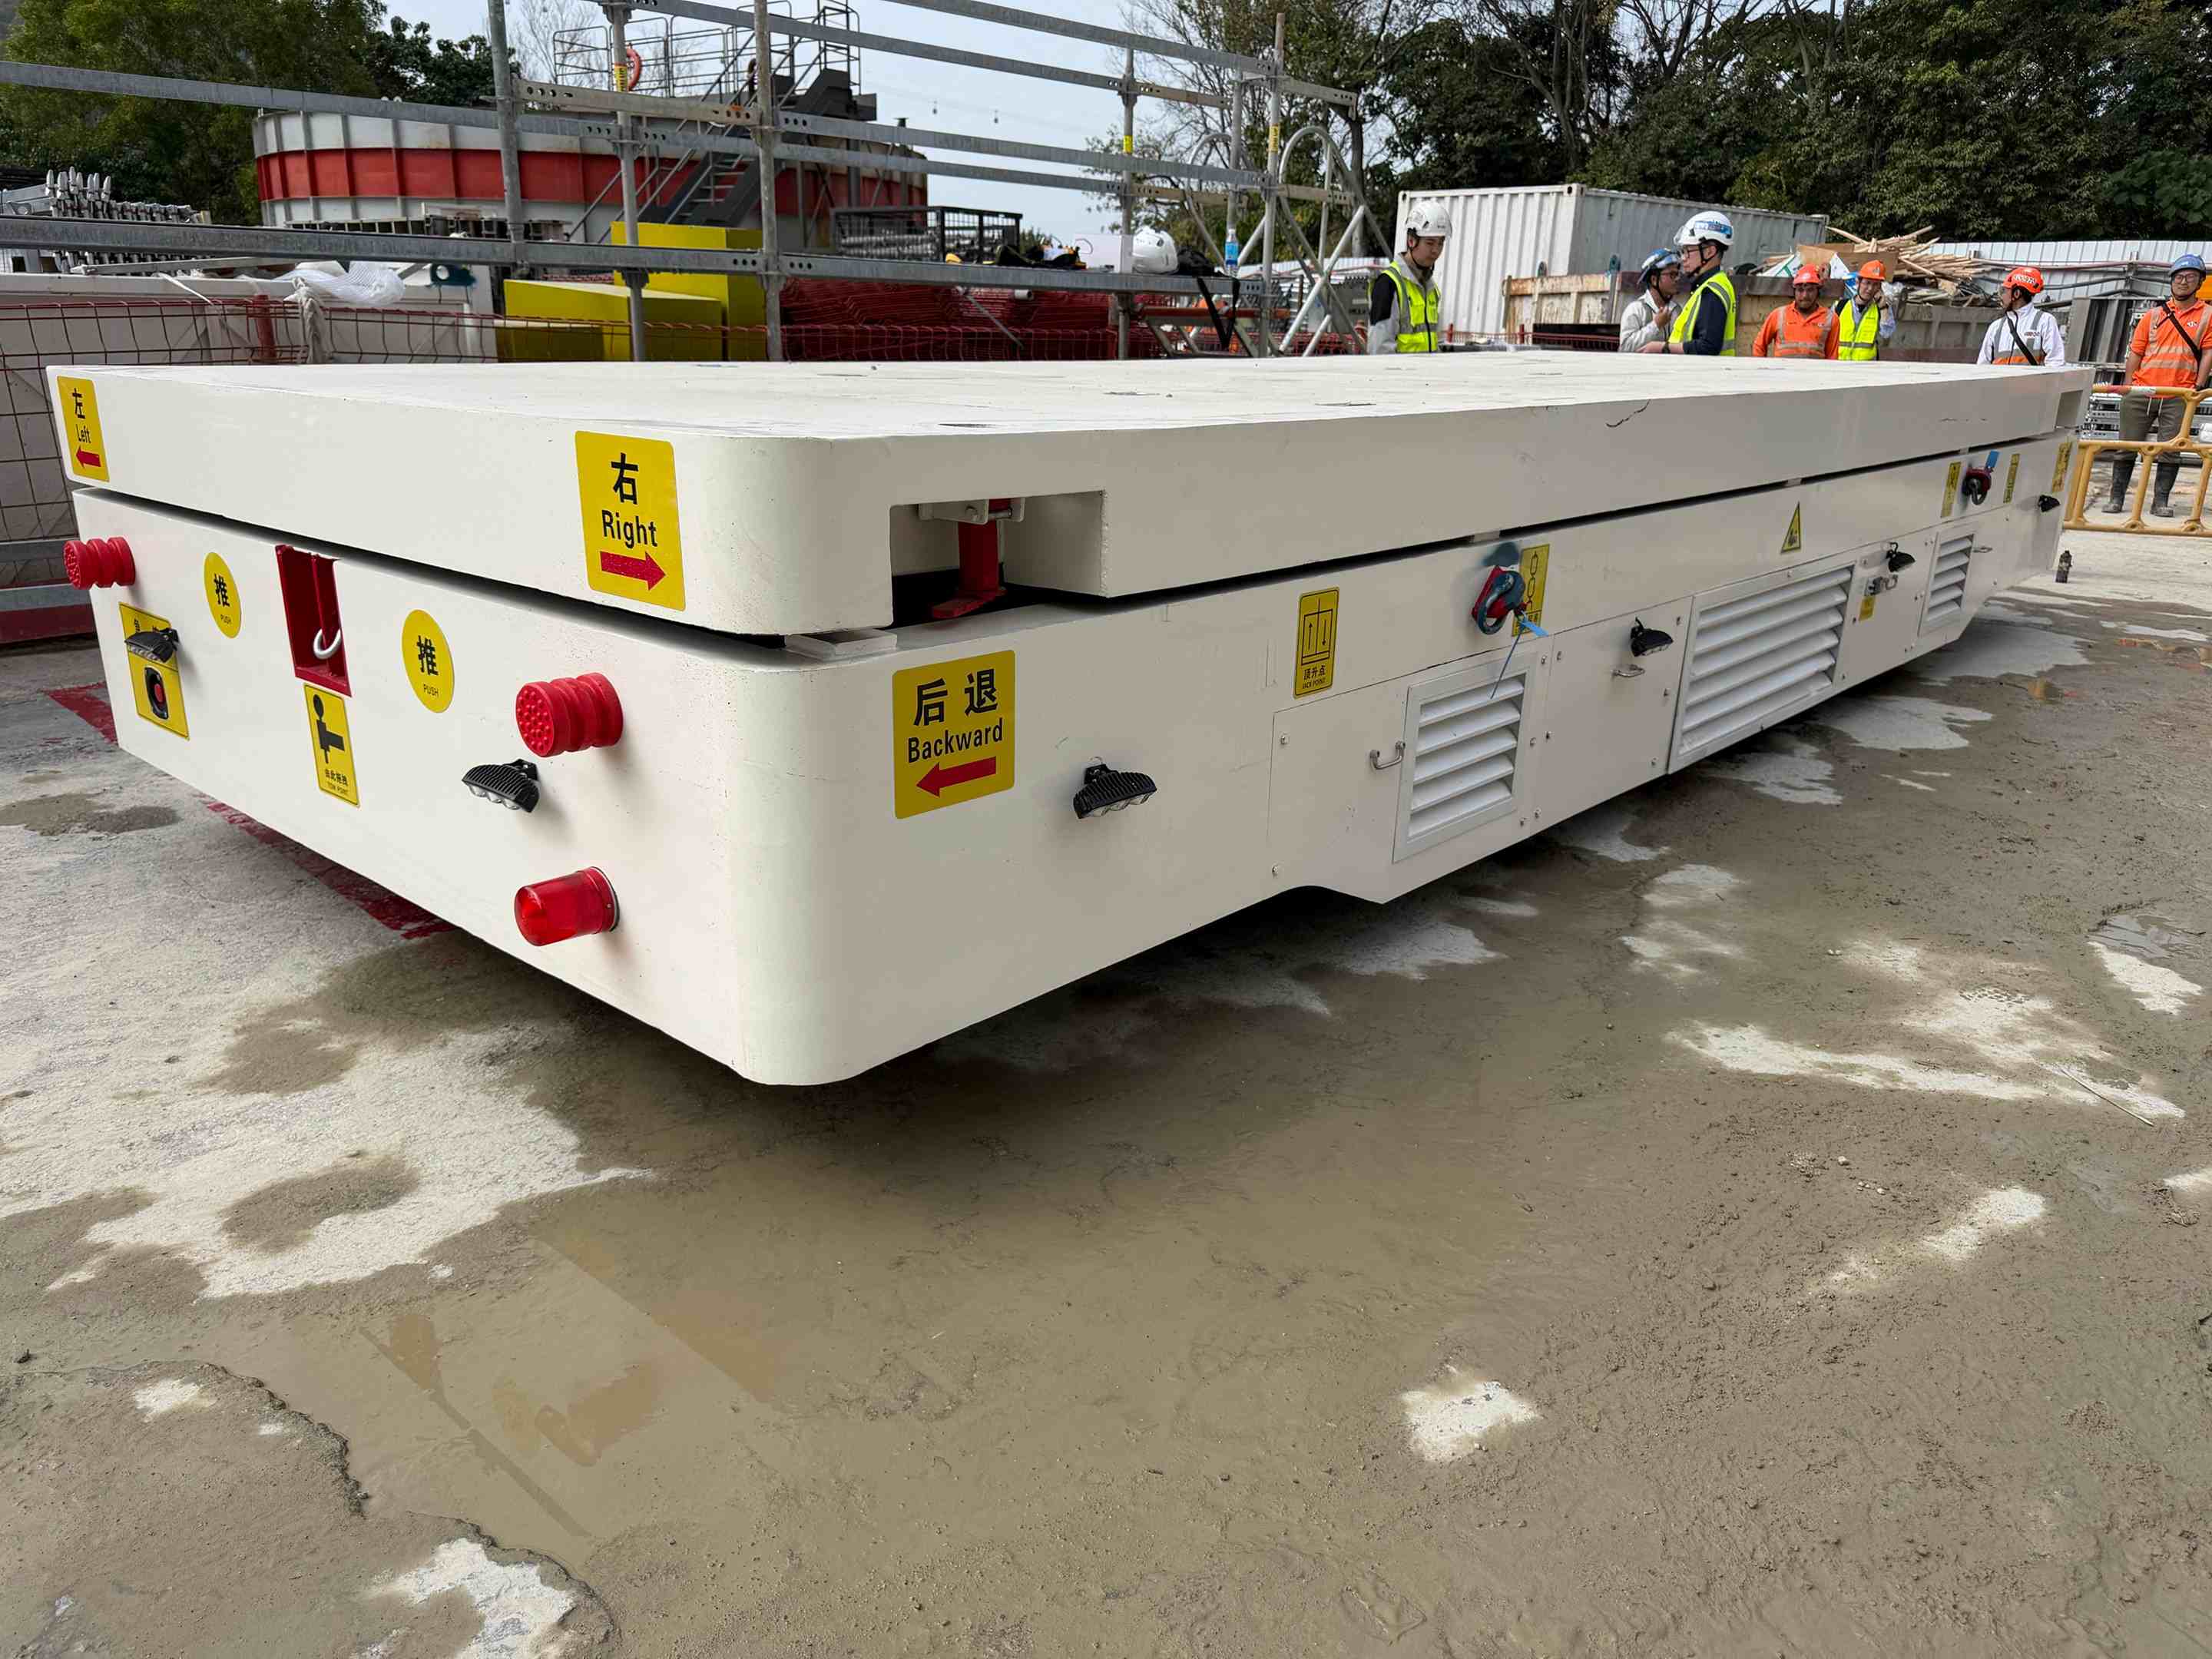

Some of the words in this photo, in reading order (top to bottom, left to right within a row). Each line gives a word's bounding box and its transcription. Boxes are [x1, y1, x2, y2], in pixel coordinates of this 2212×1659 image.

[71, 387, 86, 419] 左
[75, 424, 91, 444] Left
[611, 452, 639, 505] 右
[601, 509, 658, 549] Right
[214, 572, 230, 608] 推
[416, 634, 439, 676] 推
[422, 683, 440, 697] PUSH
[912, 667, 998, 727] 后退
[907, 717, 1003, 763] Backward
